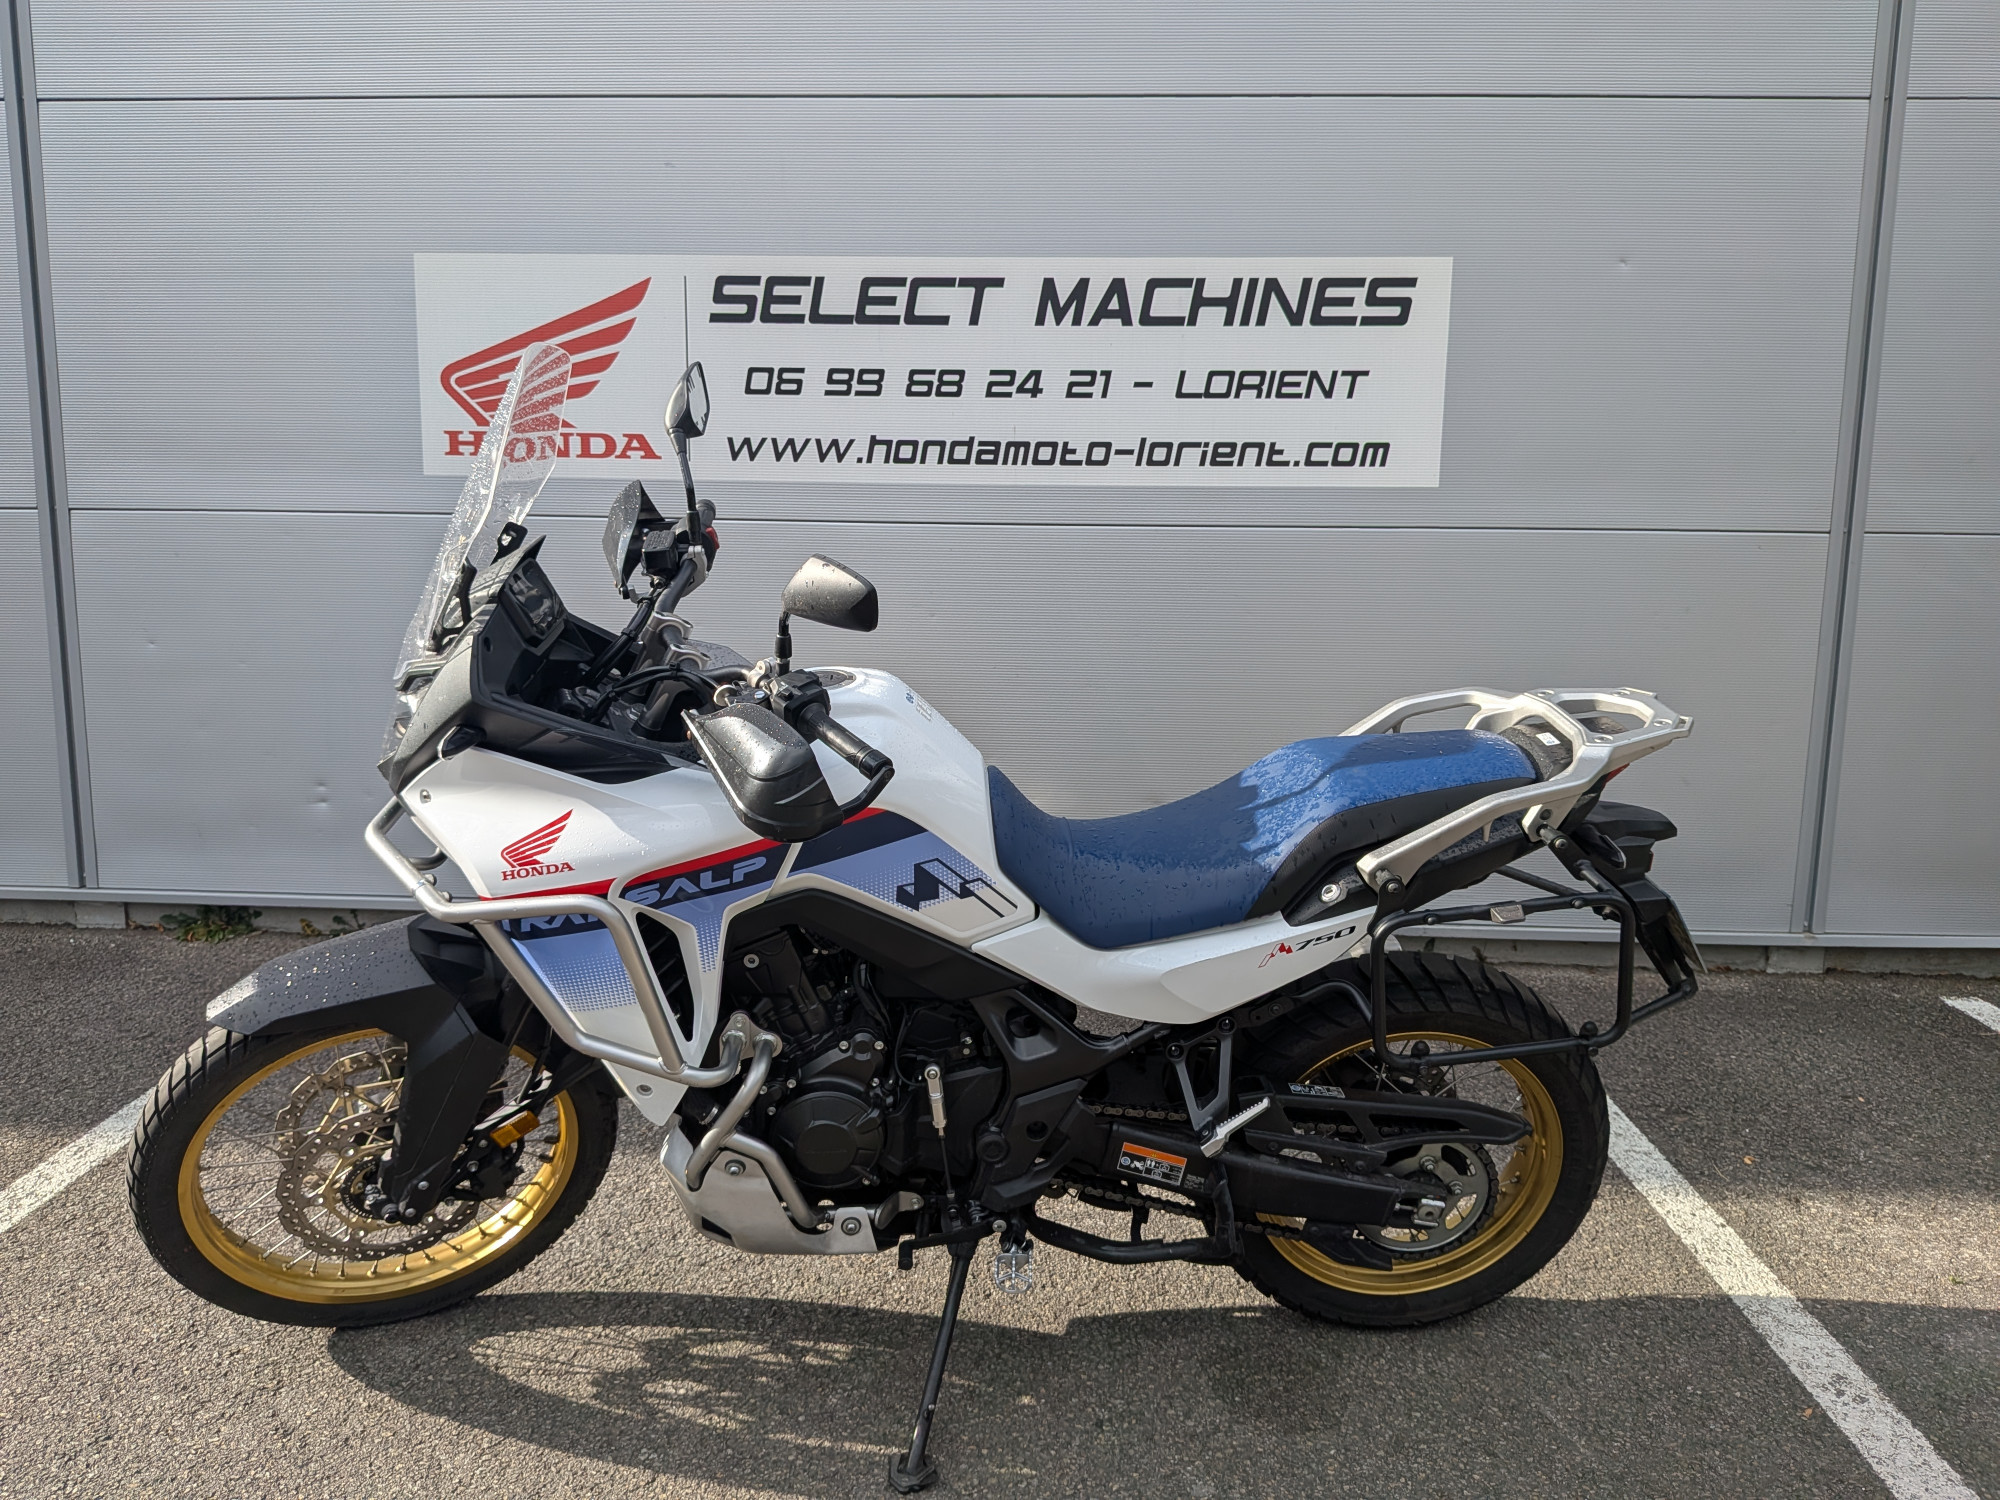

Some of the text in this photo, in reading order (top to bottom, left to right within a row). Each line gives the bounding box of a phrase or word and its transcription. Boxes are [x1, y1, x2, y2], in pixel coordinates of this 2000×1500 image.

[708, 275, 1419, 327] SELECT MACHINES
[744, 366, 806, 396] 06
[824, 367, 886, 397] 99
[905, 368, 966, 398] 68
[984, 369, 1044, 399] 24
[1065, 369, 1113, 399] 21
[1175, 370, 1370, 399] LORIENT
[443, 430, 662, 463] HONDA
[726, 434, 1391, 468] www.hondamoto-lorient.com
[501, 862, 576, 881] HONDA
[1295, 925, 1357, 952] 750
